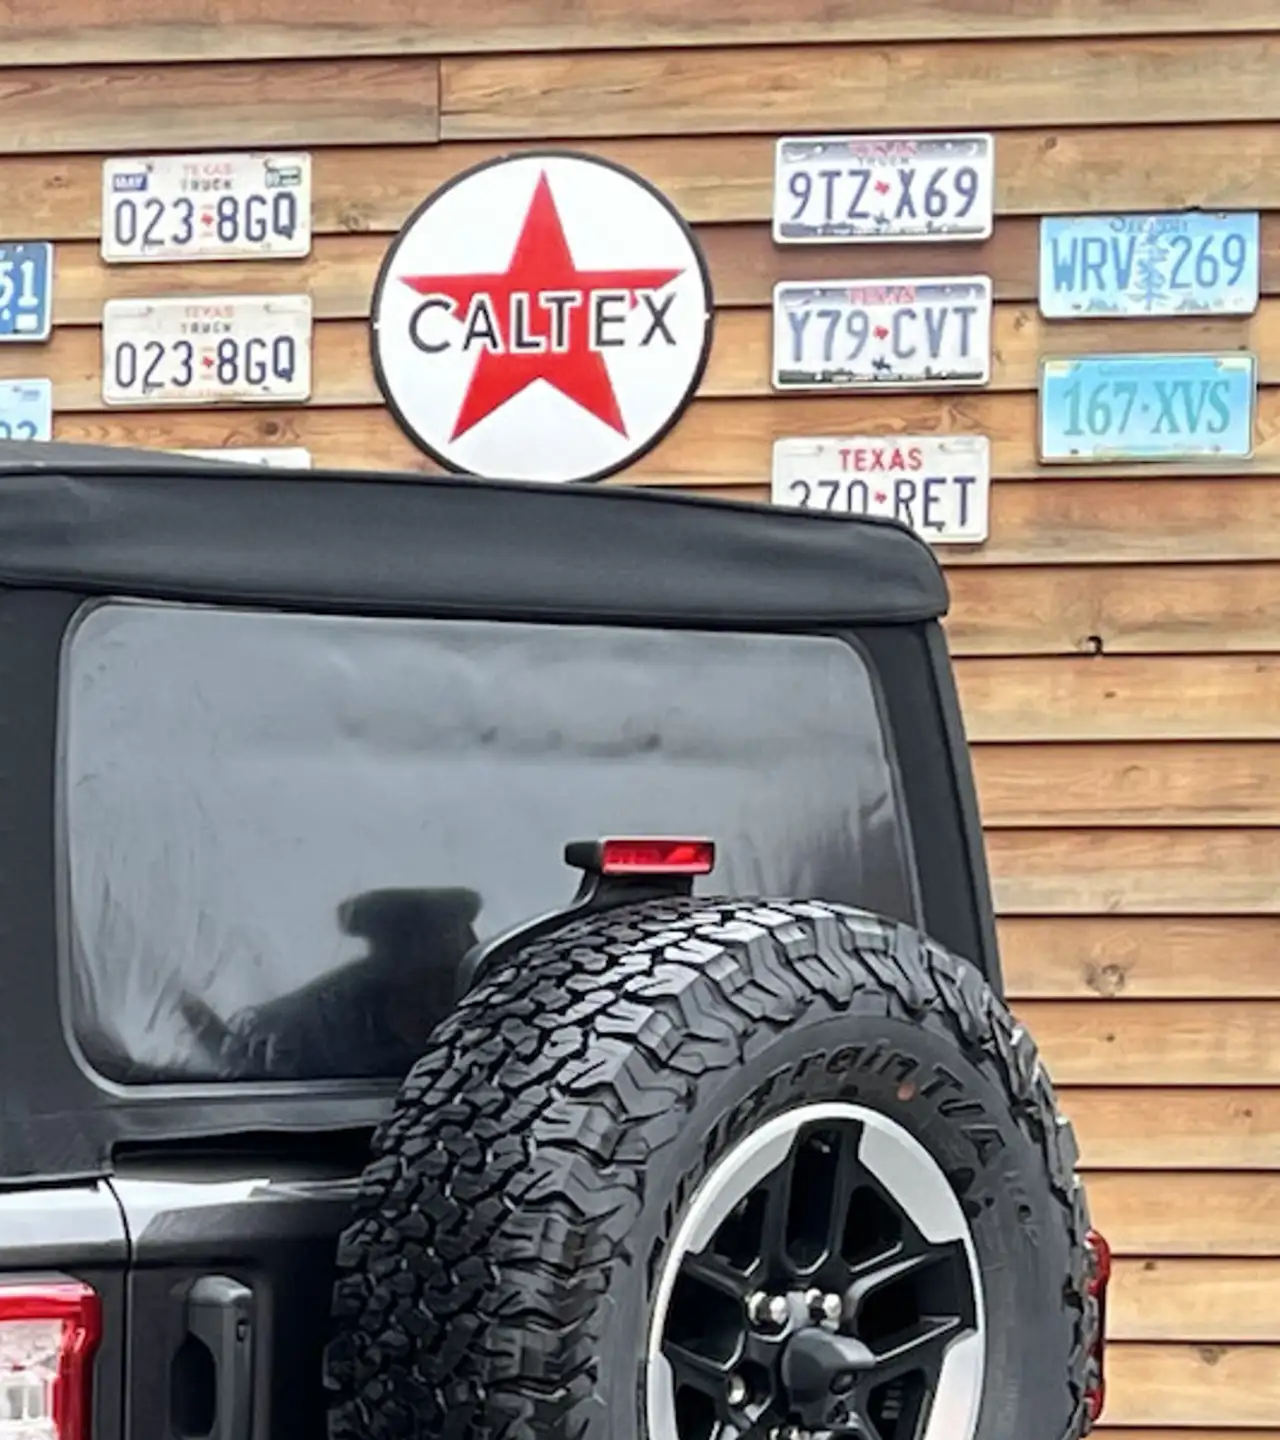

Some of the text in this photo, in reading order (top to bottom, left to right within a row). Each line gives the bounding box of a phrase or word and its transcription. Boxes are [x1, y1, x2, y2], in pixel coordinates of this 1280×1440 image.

[114, 192, 297, 247] 023 8GQ
[789, 166, 978, 220] 9TZ X69
[1051, 233, 1247, 292] WRV 269
[408, 292, 677, 354] CALTEX
[788, 306, 978, 363] Y79 CVT
[114, 335, 296, 389] 023 8GQ
[838, 447, 924, 473] TEXAS
[894, 475, 977, 530] RET
